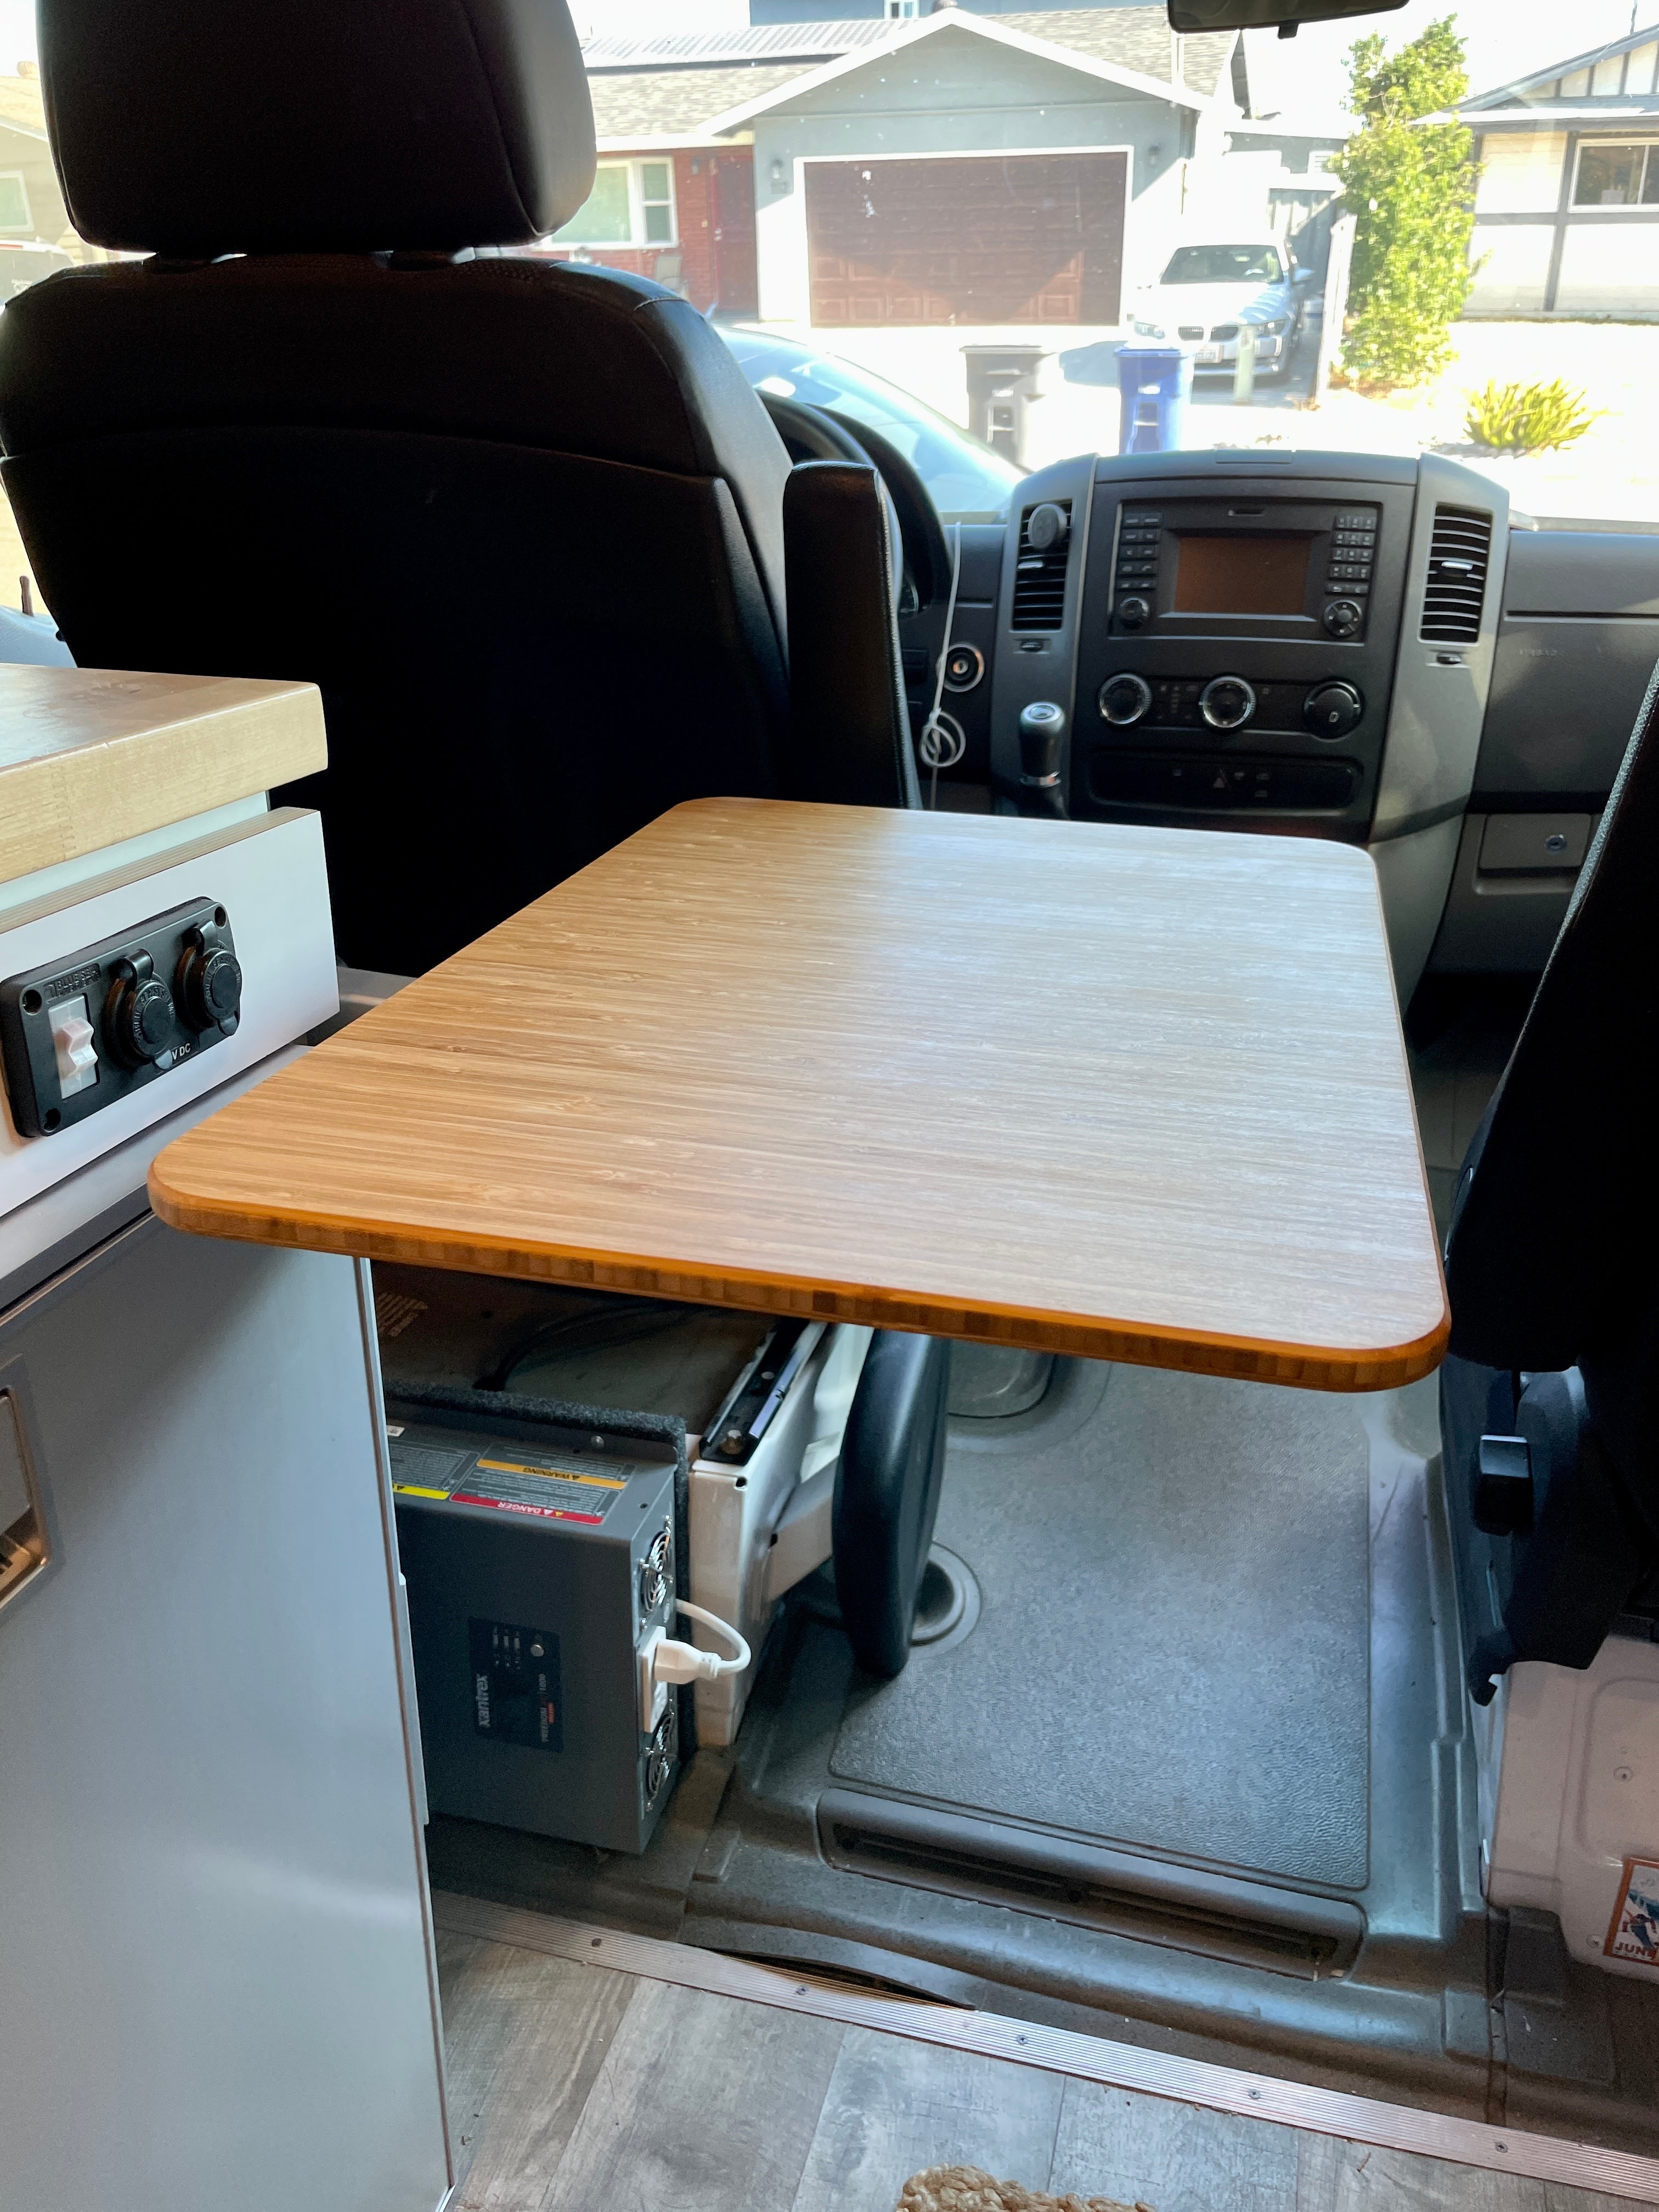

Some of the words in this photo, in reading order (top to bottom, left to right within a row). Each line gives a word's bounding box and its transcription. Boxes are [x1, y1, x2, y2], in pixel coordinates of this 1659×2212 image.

[522, 1467, 569, 1480] WARNING
[497, 1501, 541, 1515] DANGER
[476, 1673, 491, 1728] xantrex
